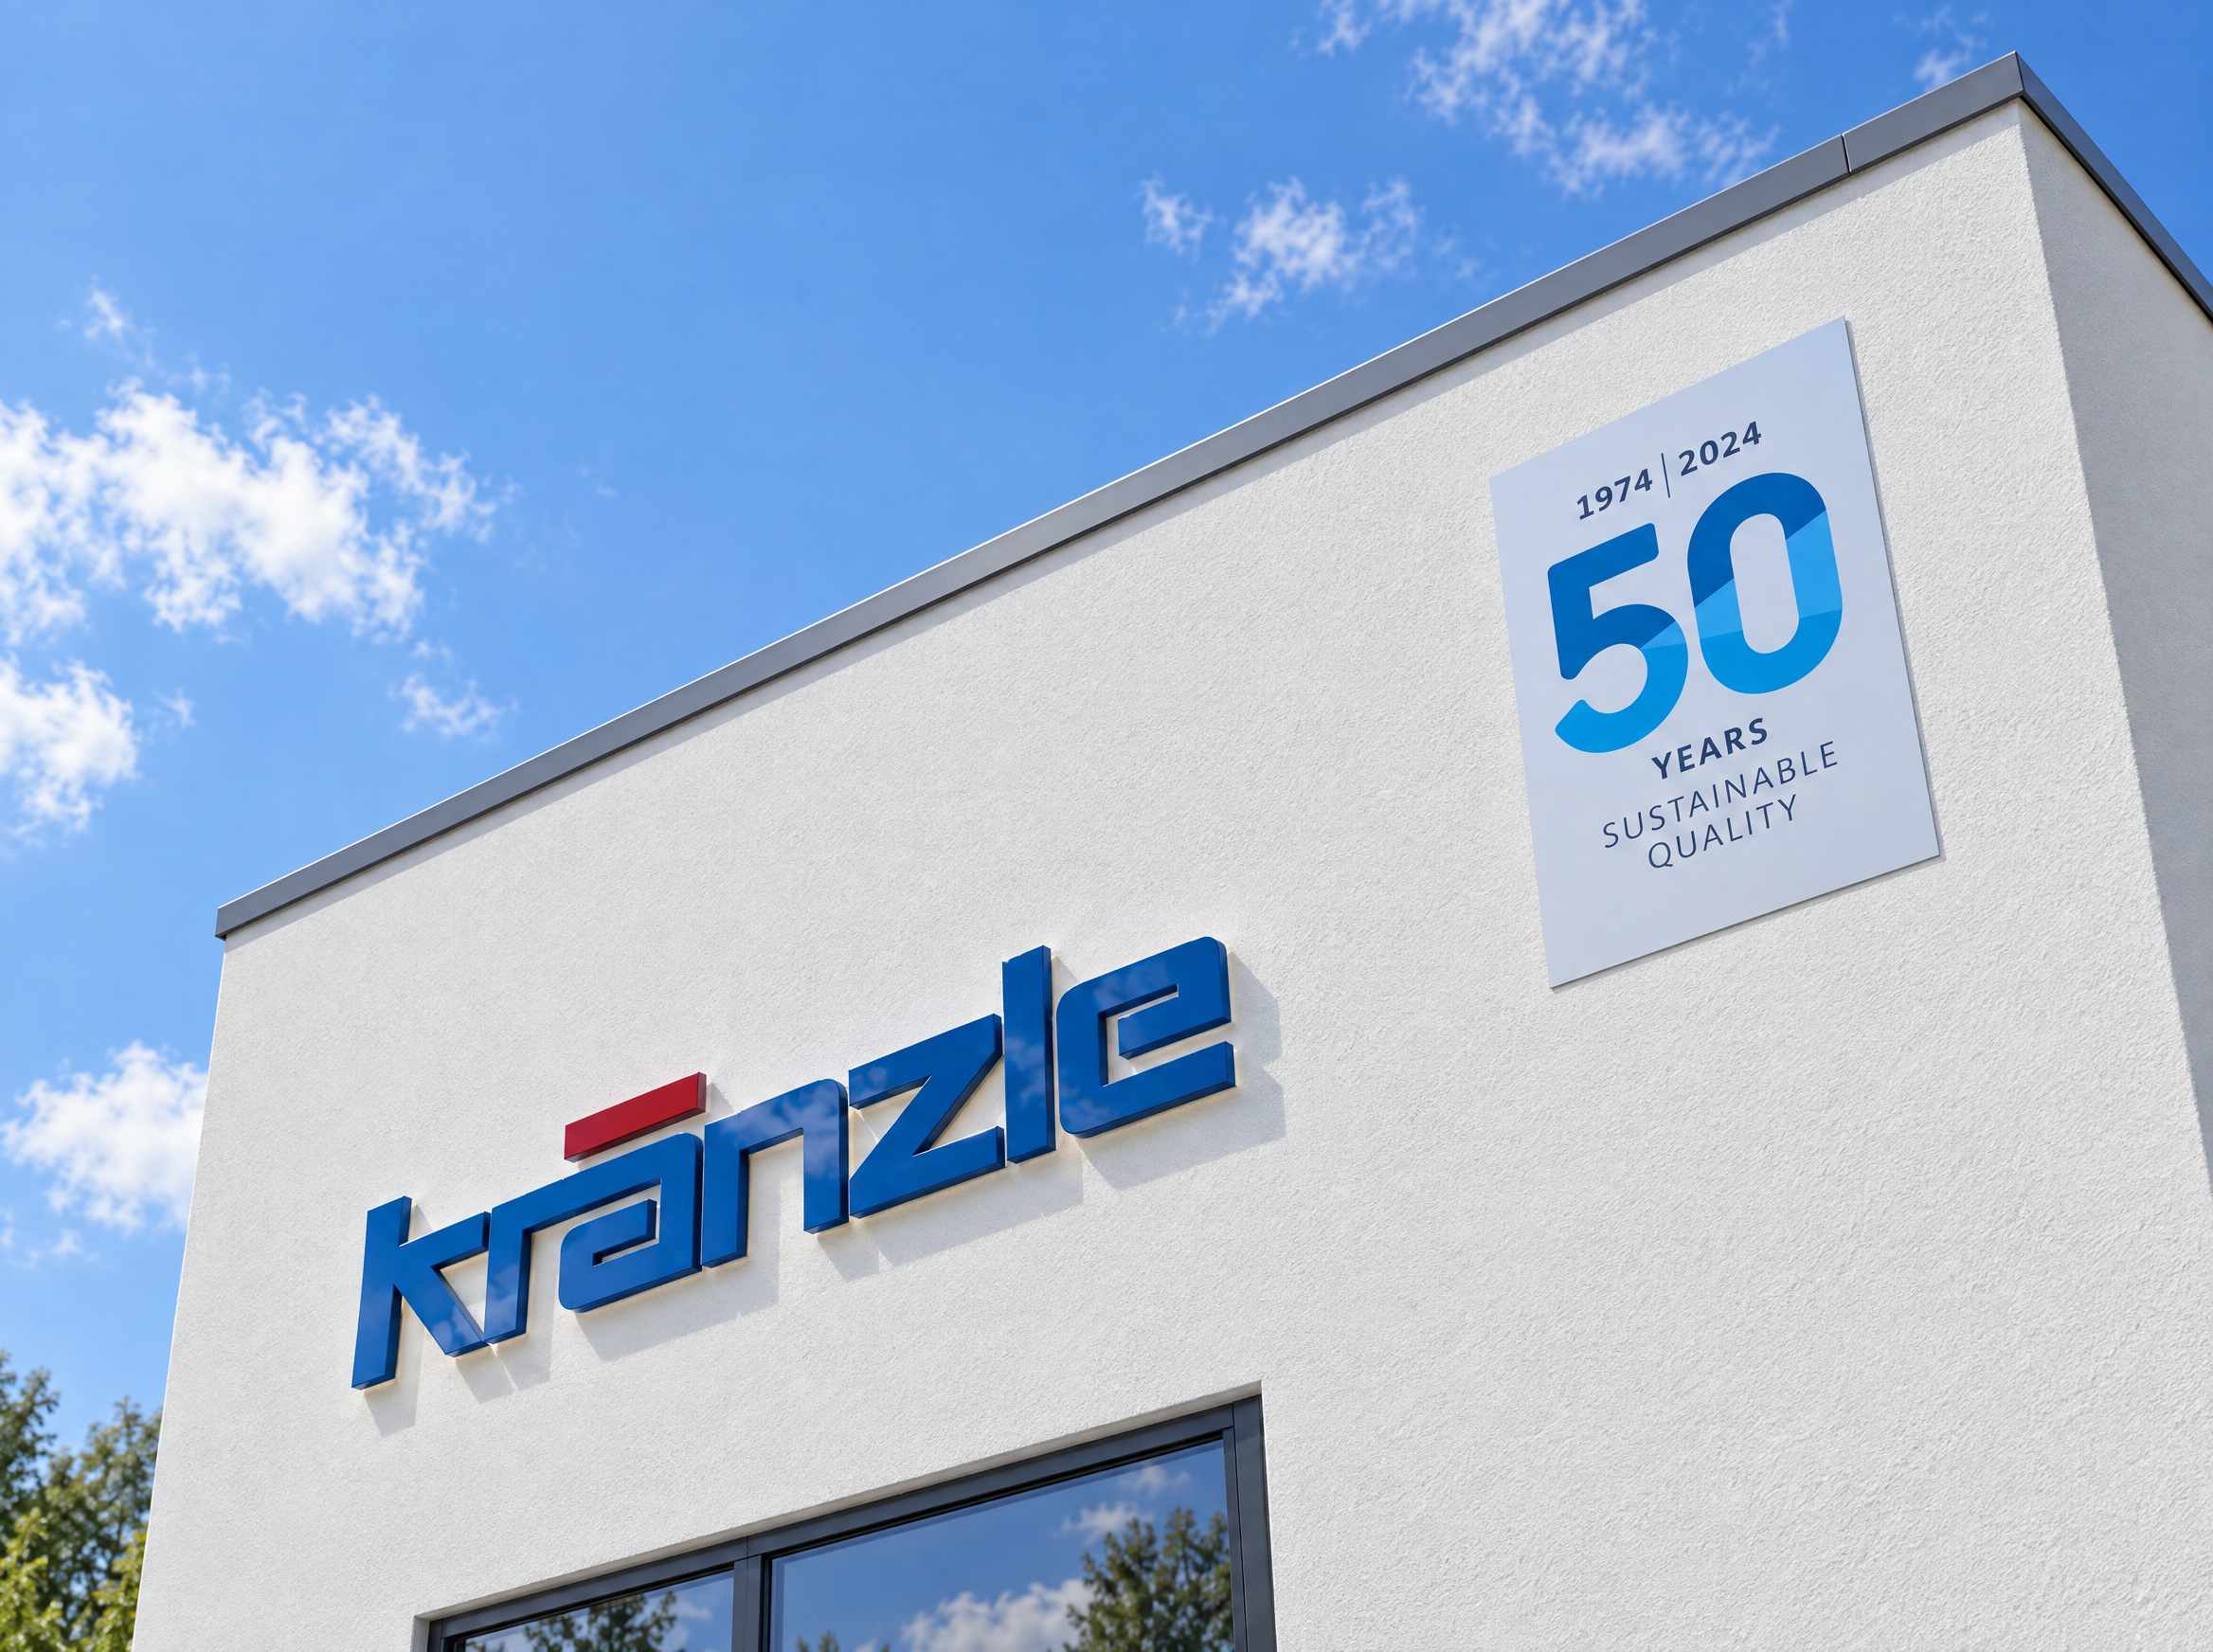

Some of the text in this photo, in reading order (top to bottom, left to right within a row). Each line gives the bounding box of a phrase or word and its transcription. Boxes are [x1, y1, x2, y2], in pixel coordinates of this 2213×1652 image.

[1576, 421, 1762, 520] 1974 2024
[1547, 472, 1843, 753] 50
[1603, 740, 1838, 849] SUSTAINABLE
[1651, 717, 1769, 781] YEARS
[1647, 794, 1797, 870] QUALITY
